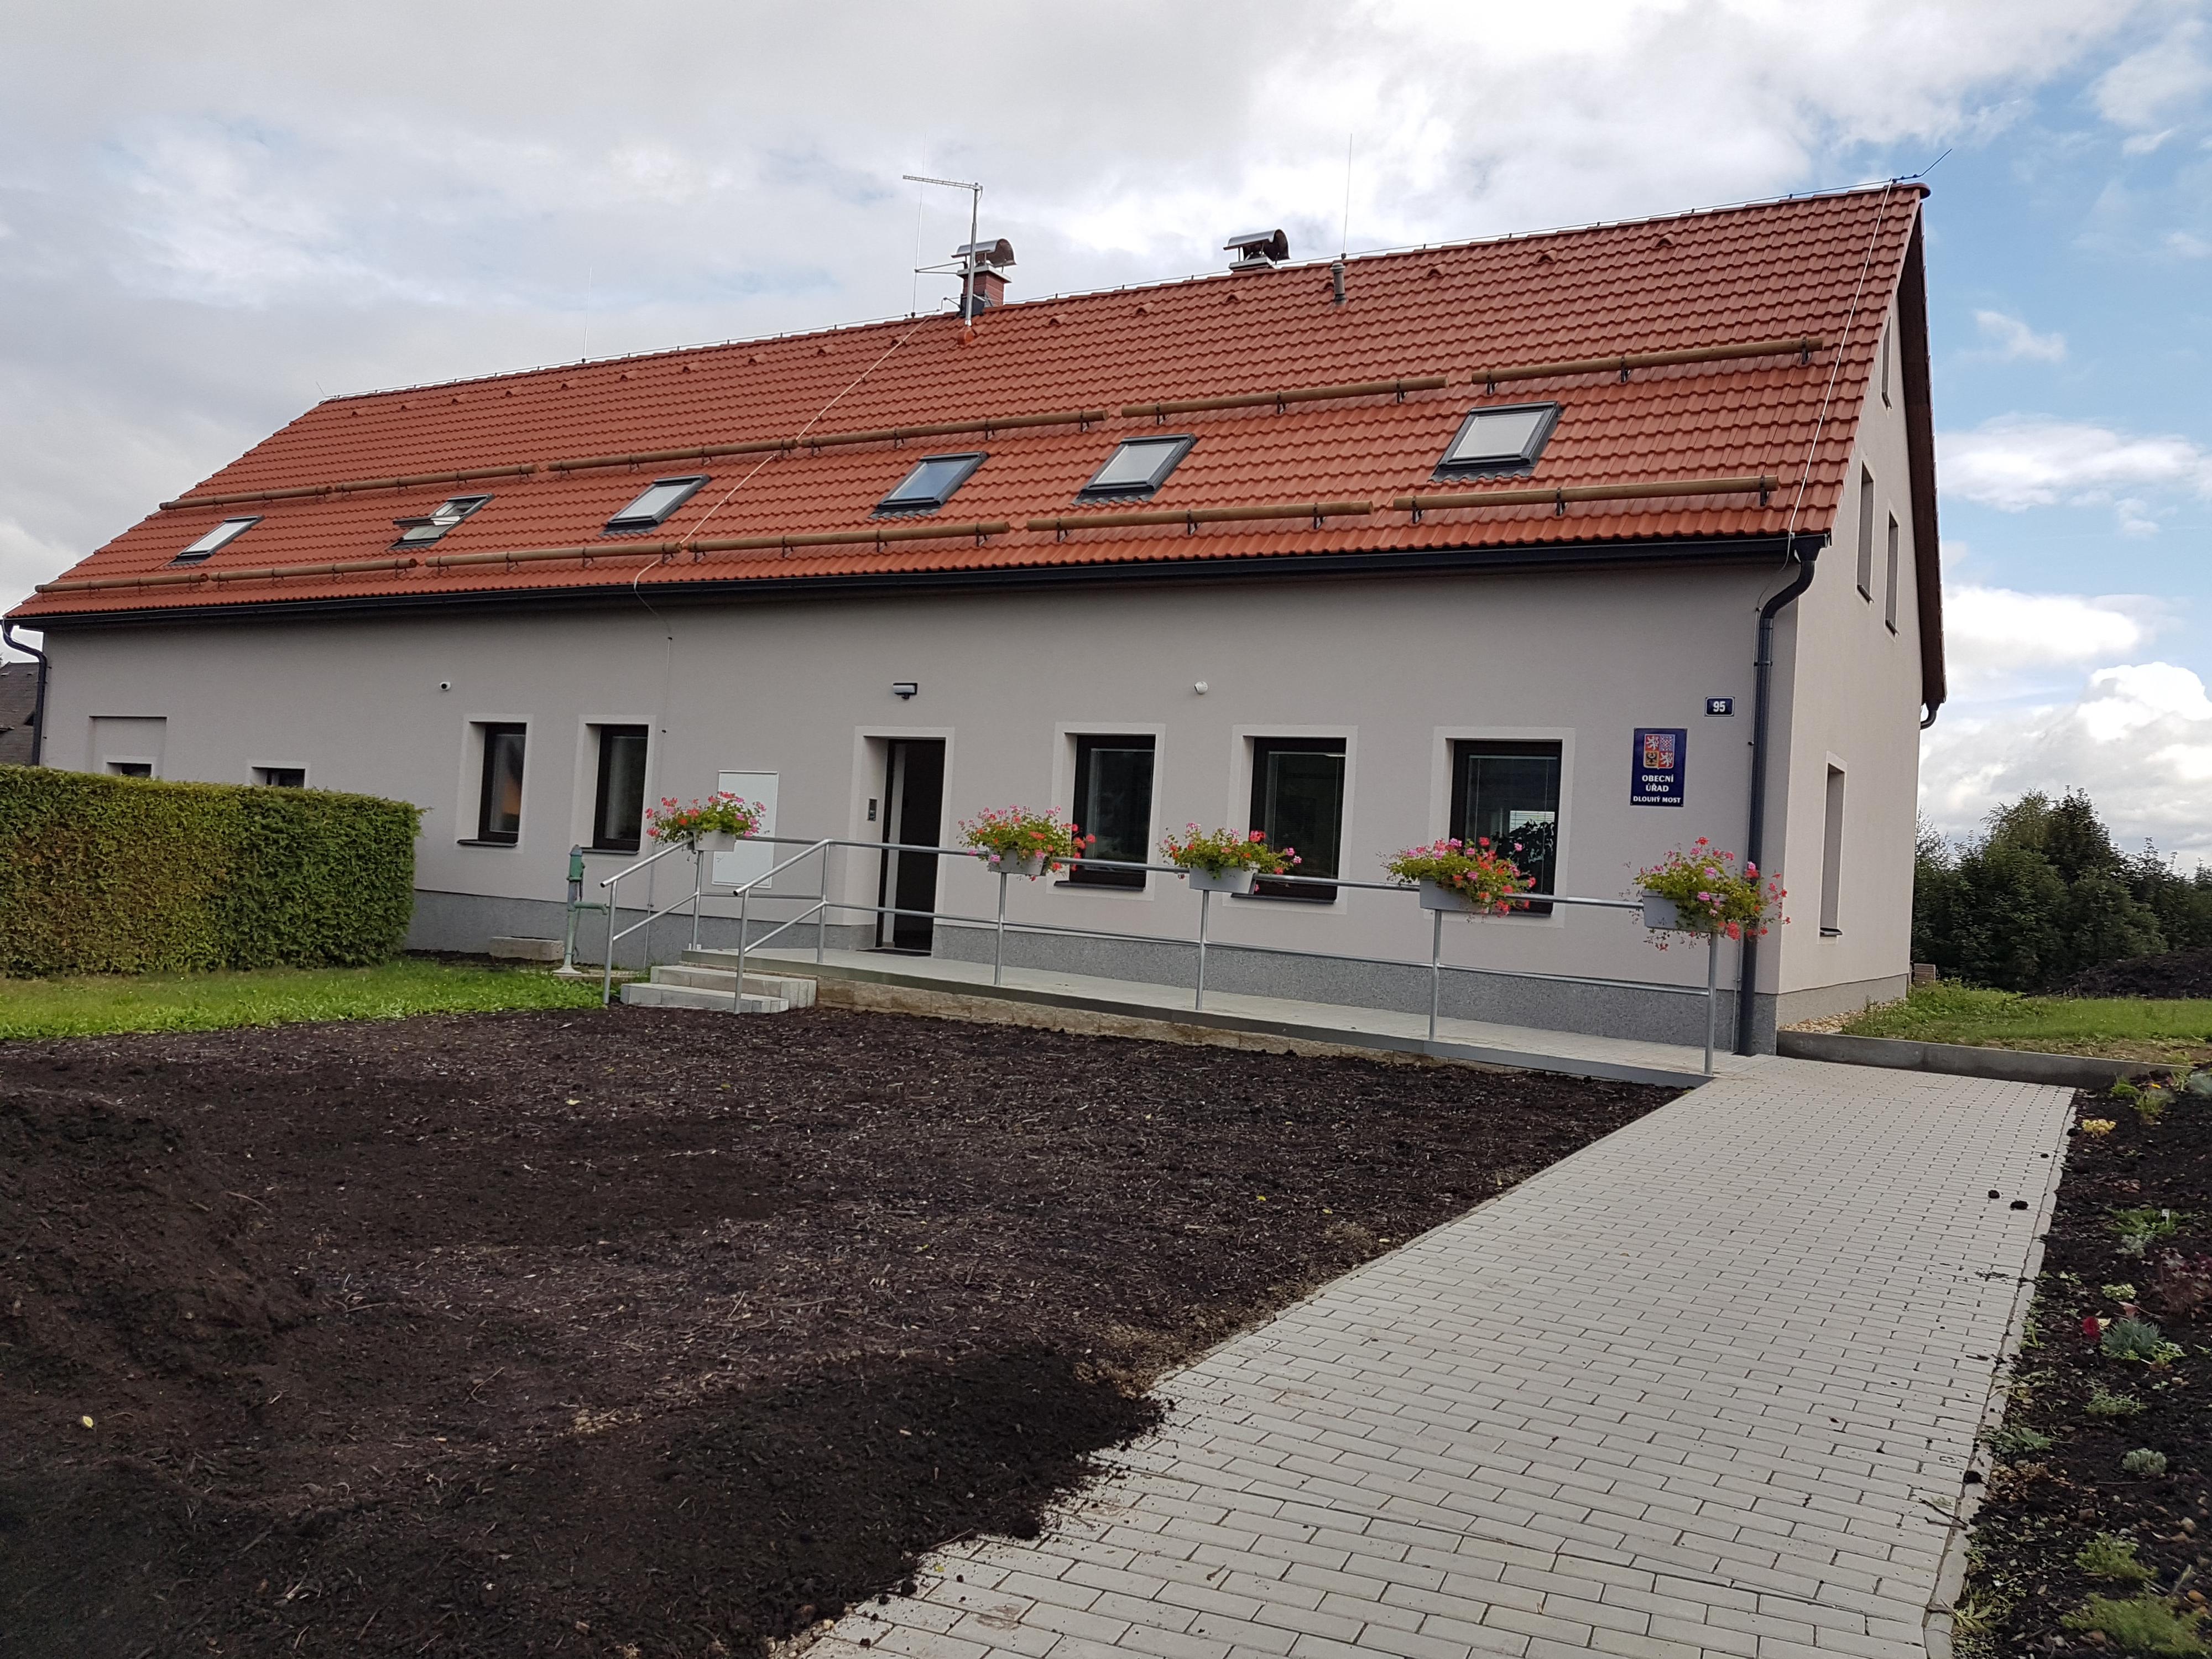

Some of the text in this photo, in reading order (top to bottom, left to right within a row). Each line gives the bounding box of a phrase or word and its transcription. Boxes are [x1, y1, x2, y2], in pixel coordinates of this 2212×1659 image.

[1713, 701, 1725, 712] 95
[1642, 774, 1674, 782] OBECNÍ
[1645, 783, 1669, 792] ÚŘAD
